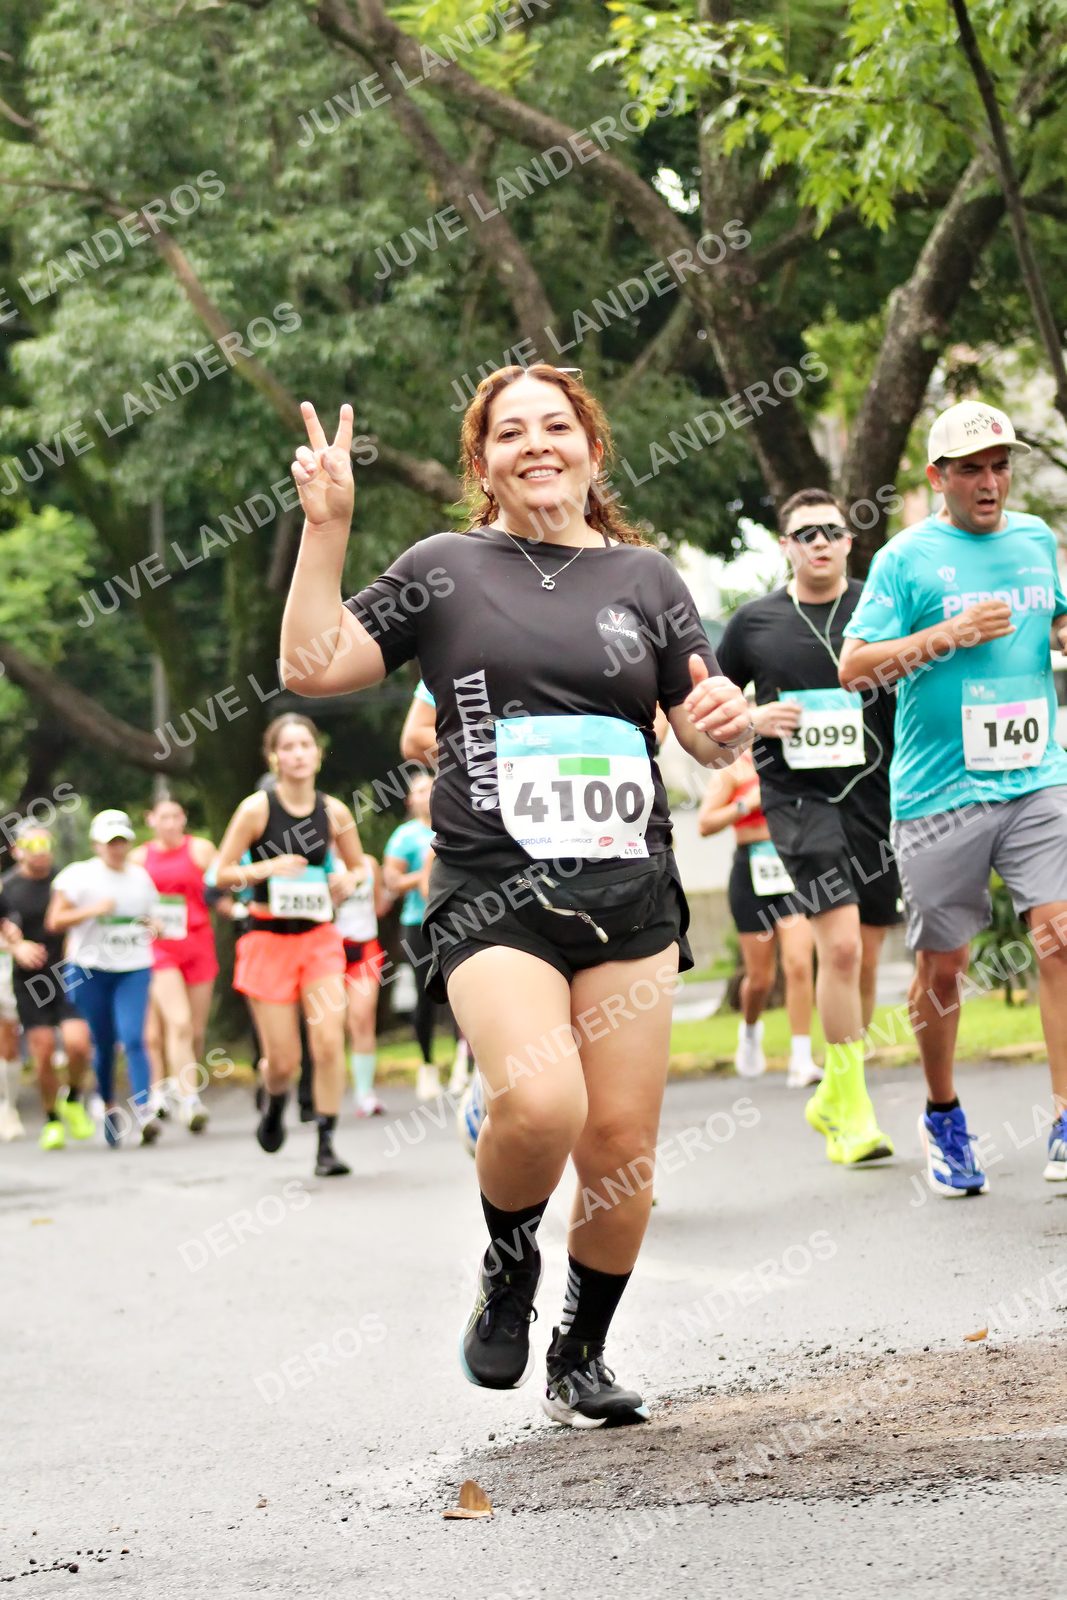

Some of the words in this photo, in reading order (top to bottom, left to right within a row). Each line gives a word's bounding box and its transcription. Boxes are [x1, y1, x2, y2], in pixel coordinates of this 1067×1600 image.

[453, 669, 500, 811] VILLANOS
[984, 717, 1039, 748] 140
[514, 780, 645, 823] 4100
[624, 848, 643, 856] 4100
